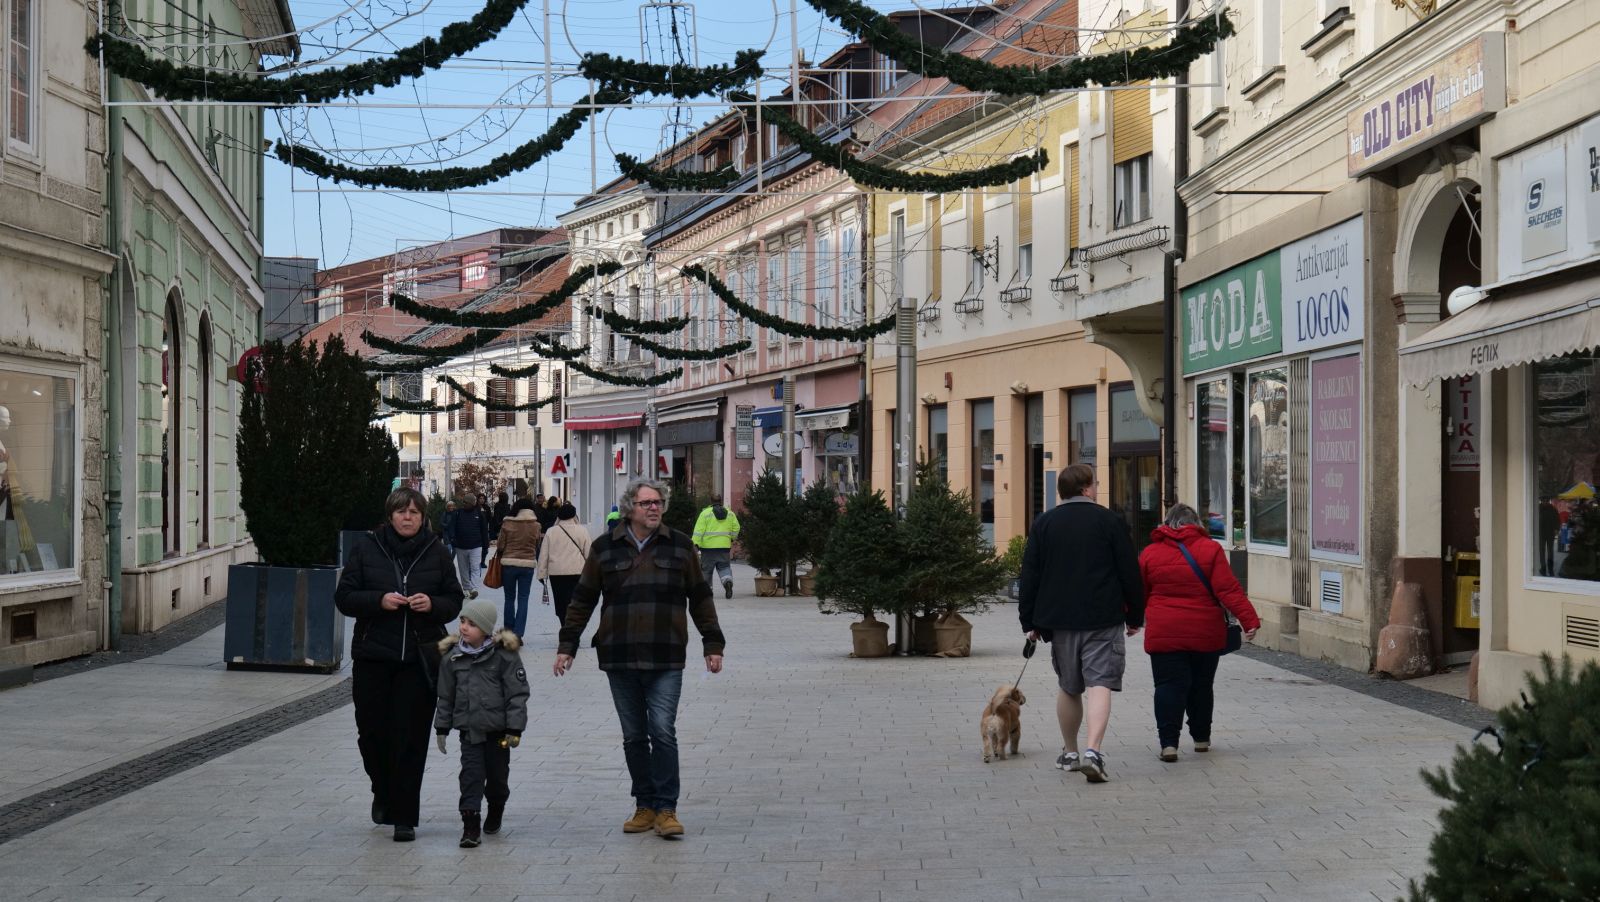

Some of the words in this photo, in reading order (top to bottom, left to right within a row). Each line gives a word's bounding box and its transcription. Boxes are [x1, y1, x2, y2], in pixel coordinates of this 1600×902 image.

[1350, 132, 1364, 155] bar
[1364, 100, 1391, 158] OLD
[1396, 75, 1435, 141] CITY
[1436, 77, 1459, 113] night
[1463, 62, 1484, 98] club
[1528, 182, 1543, 210] S
[1527, 206, 1563, 228] SKECHERS
[1296, 235, 1349, 283] Antikvarijat
[1188, 269, 1273, 361] MODA
[1297, 286, 1350, 342] LOGOS
[1470, 343, 1499, 365] FENIX
[1318, 375, 1354, 400] RABLJENI
[1320, 404, 1353, 431] ŠKOLSKI
[1458, 373, 1475, 453] PTIKA
[551, 453, 571, 474] A1
